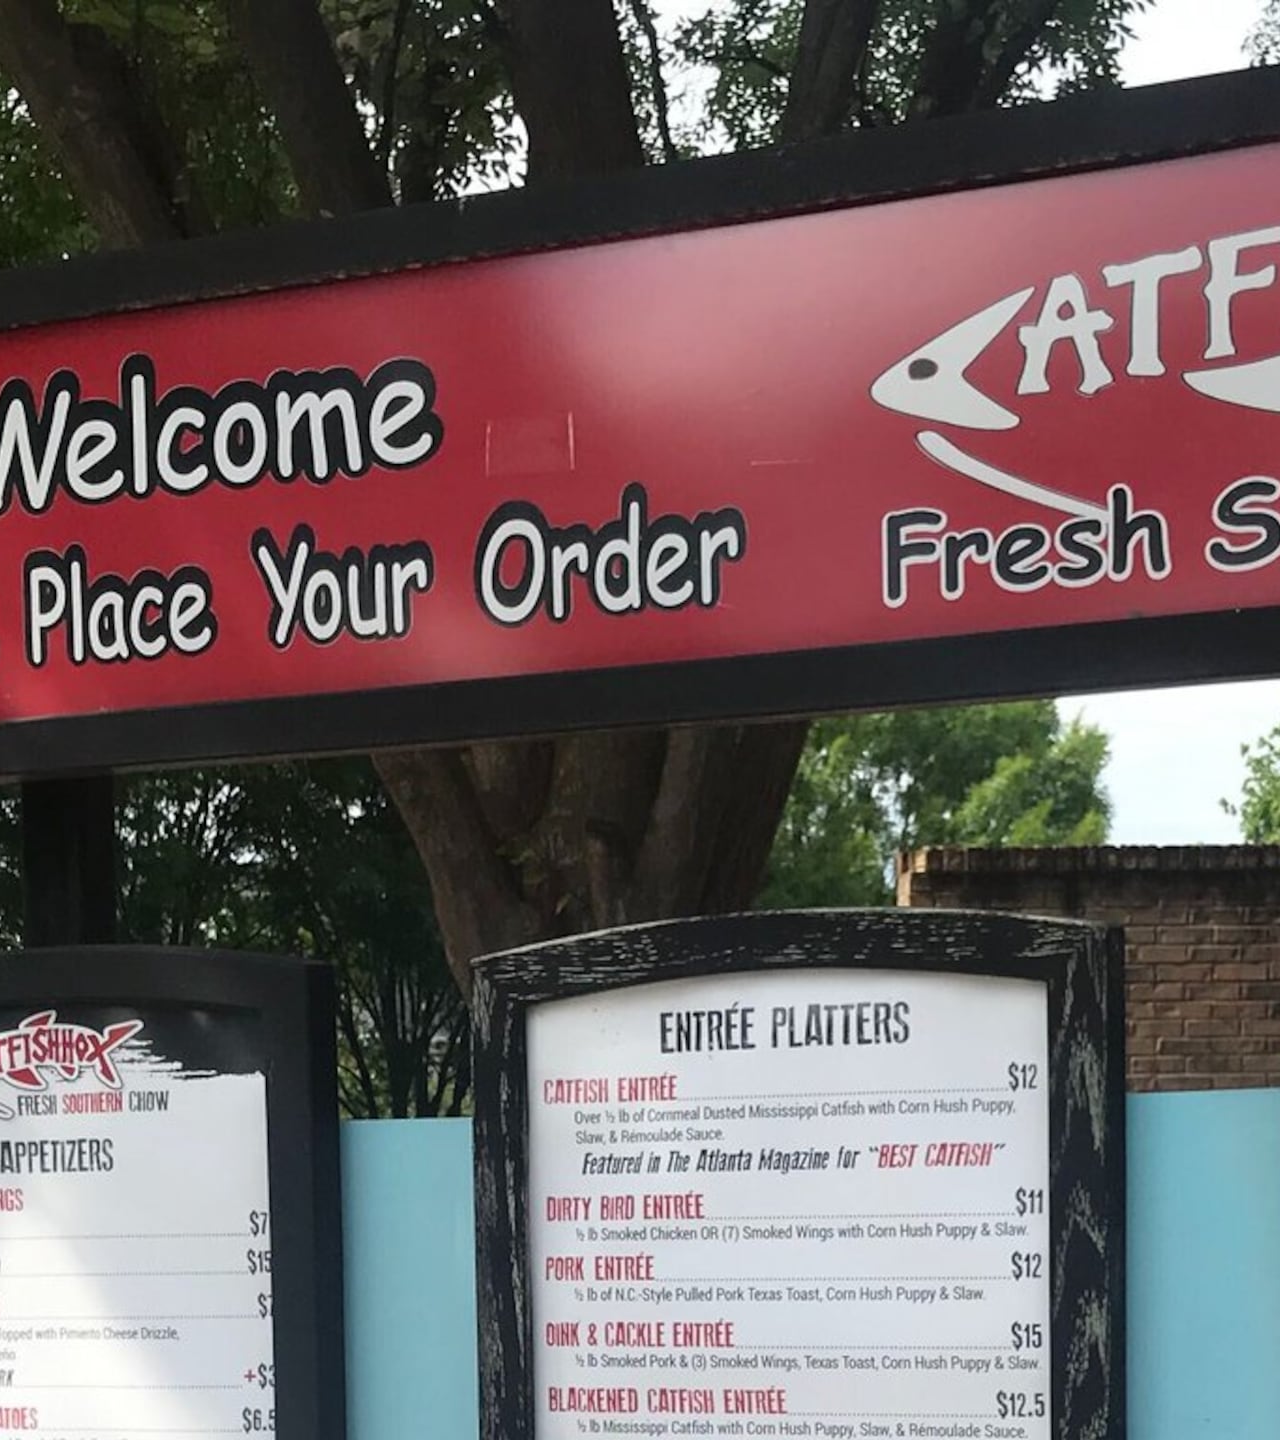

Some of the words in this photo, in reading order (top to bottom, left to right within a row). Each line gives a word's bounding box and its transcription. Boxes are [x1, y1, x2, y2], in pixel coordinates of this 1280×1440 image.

[883, 490, 1170, 606] Fresh
[28, 562, 214, 667] Place
[255, 539, 431, 648] Your
[478, 500, 744, 624] Order
[660, 1002, 755, 1053] ENTRÉE
[772, 1002, 909, 1048] PLATTERS
[544, 1079, 608, 1104] CATFISH
[618, 1073, 677, 1102] ENTRÉE
[1008, 1062, 1037, 1091] $12
[17, 1095, 57, 1116] FRESH
[63, 1092, 123, 1114] SOUTHERN
[129, 1091, 169, 1112] CHOW
[0, 1139, 113, 1173] APPETIZERS
[582, 1152, 643, 1175] Featured
[647, 1152, 661, 1173] in
[667, 1151, 690, 1172] The
[696, 1149, 752, 1172] Atlanta
[758, 1148, 829, 1174] Magazine
[837, 1146, 861, 1168] for
[546, 1196, 591, 1222] DIRTY
[601, 1195, 634, 1220] BIRD
[644, 1191, 705, 1219] ENTRÉE
[1016, 1187, 1043, 1216] $11
[546, 1257, 584, 1281] PORK
[595, 1253, 654, 1280] ENTRÉE
[1012, 1251, 1041, 1280] $12
[548, 1387, 638, 1413] BLACKENED
[648, 1388, 714, 1413] CATFISH
[723, 1386, 787, 1414] ENTRÉE
[996, 1390, 1045, 1419] $12.5
